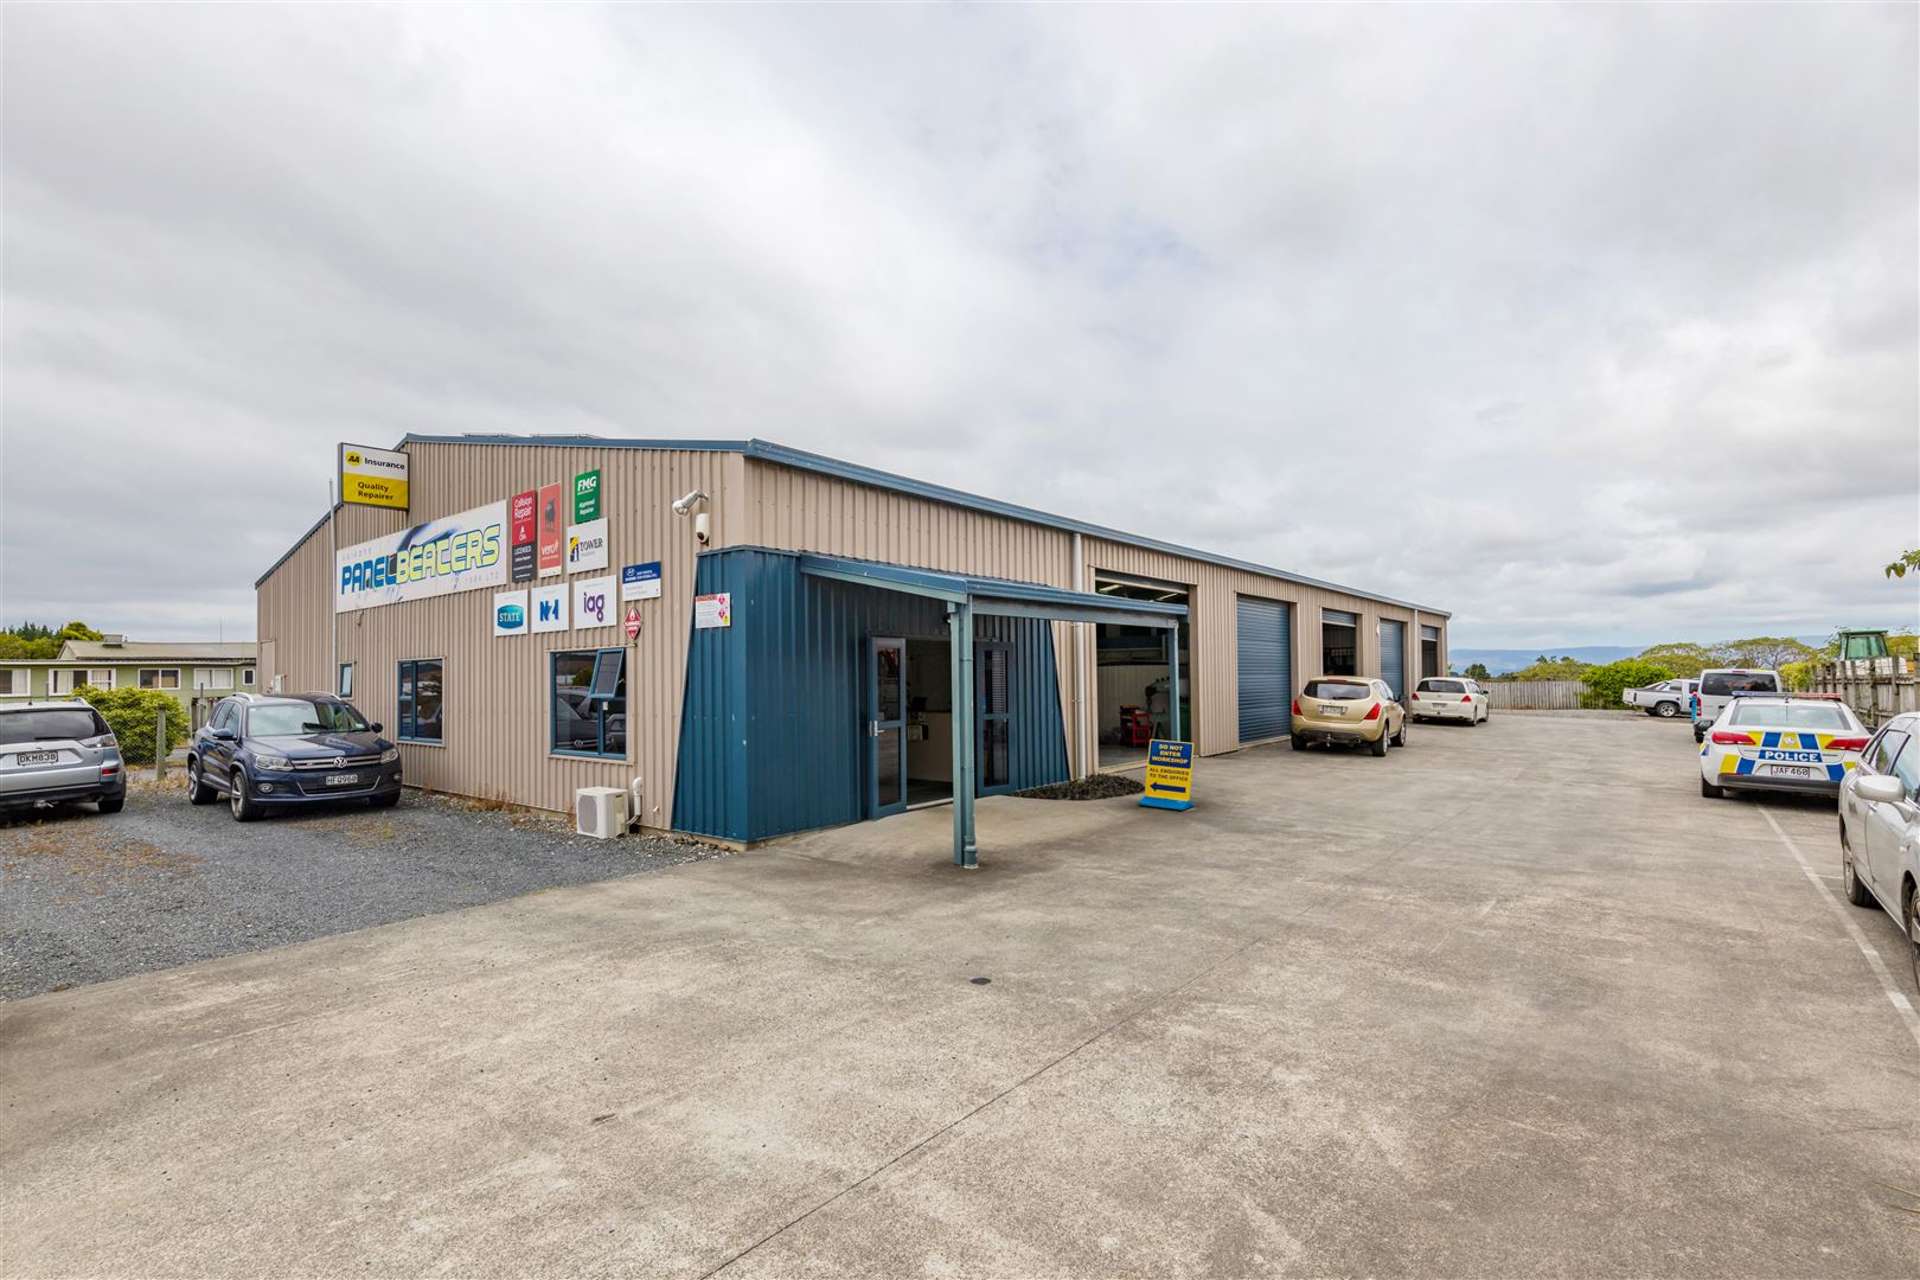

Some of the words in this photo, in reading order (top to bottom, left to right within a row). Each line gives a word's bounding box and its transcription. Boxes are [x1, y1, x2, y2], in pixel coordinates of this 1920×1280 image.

[364, 457, 405, 470] Insurance
[358, 481, 389, 492] Quality
[578, 476, 596, 491] FMG
[358, 490, 394, 501] Repairer
[580, 538, 602, 552] TOWER
[397, 524, 500, 585] BEATERS
[584, 592, 604, 622] iag
[499, 612, 520, 622] STATE
[1765, 751, 1818, 761] POLICE
